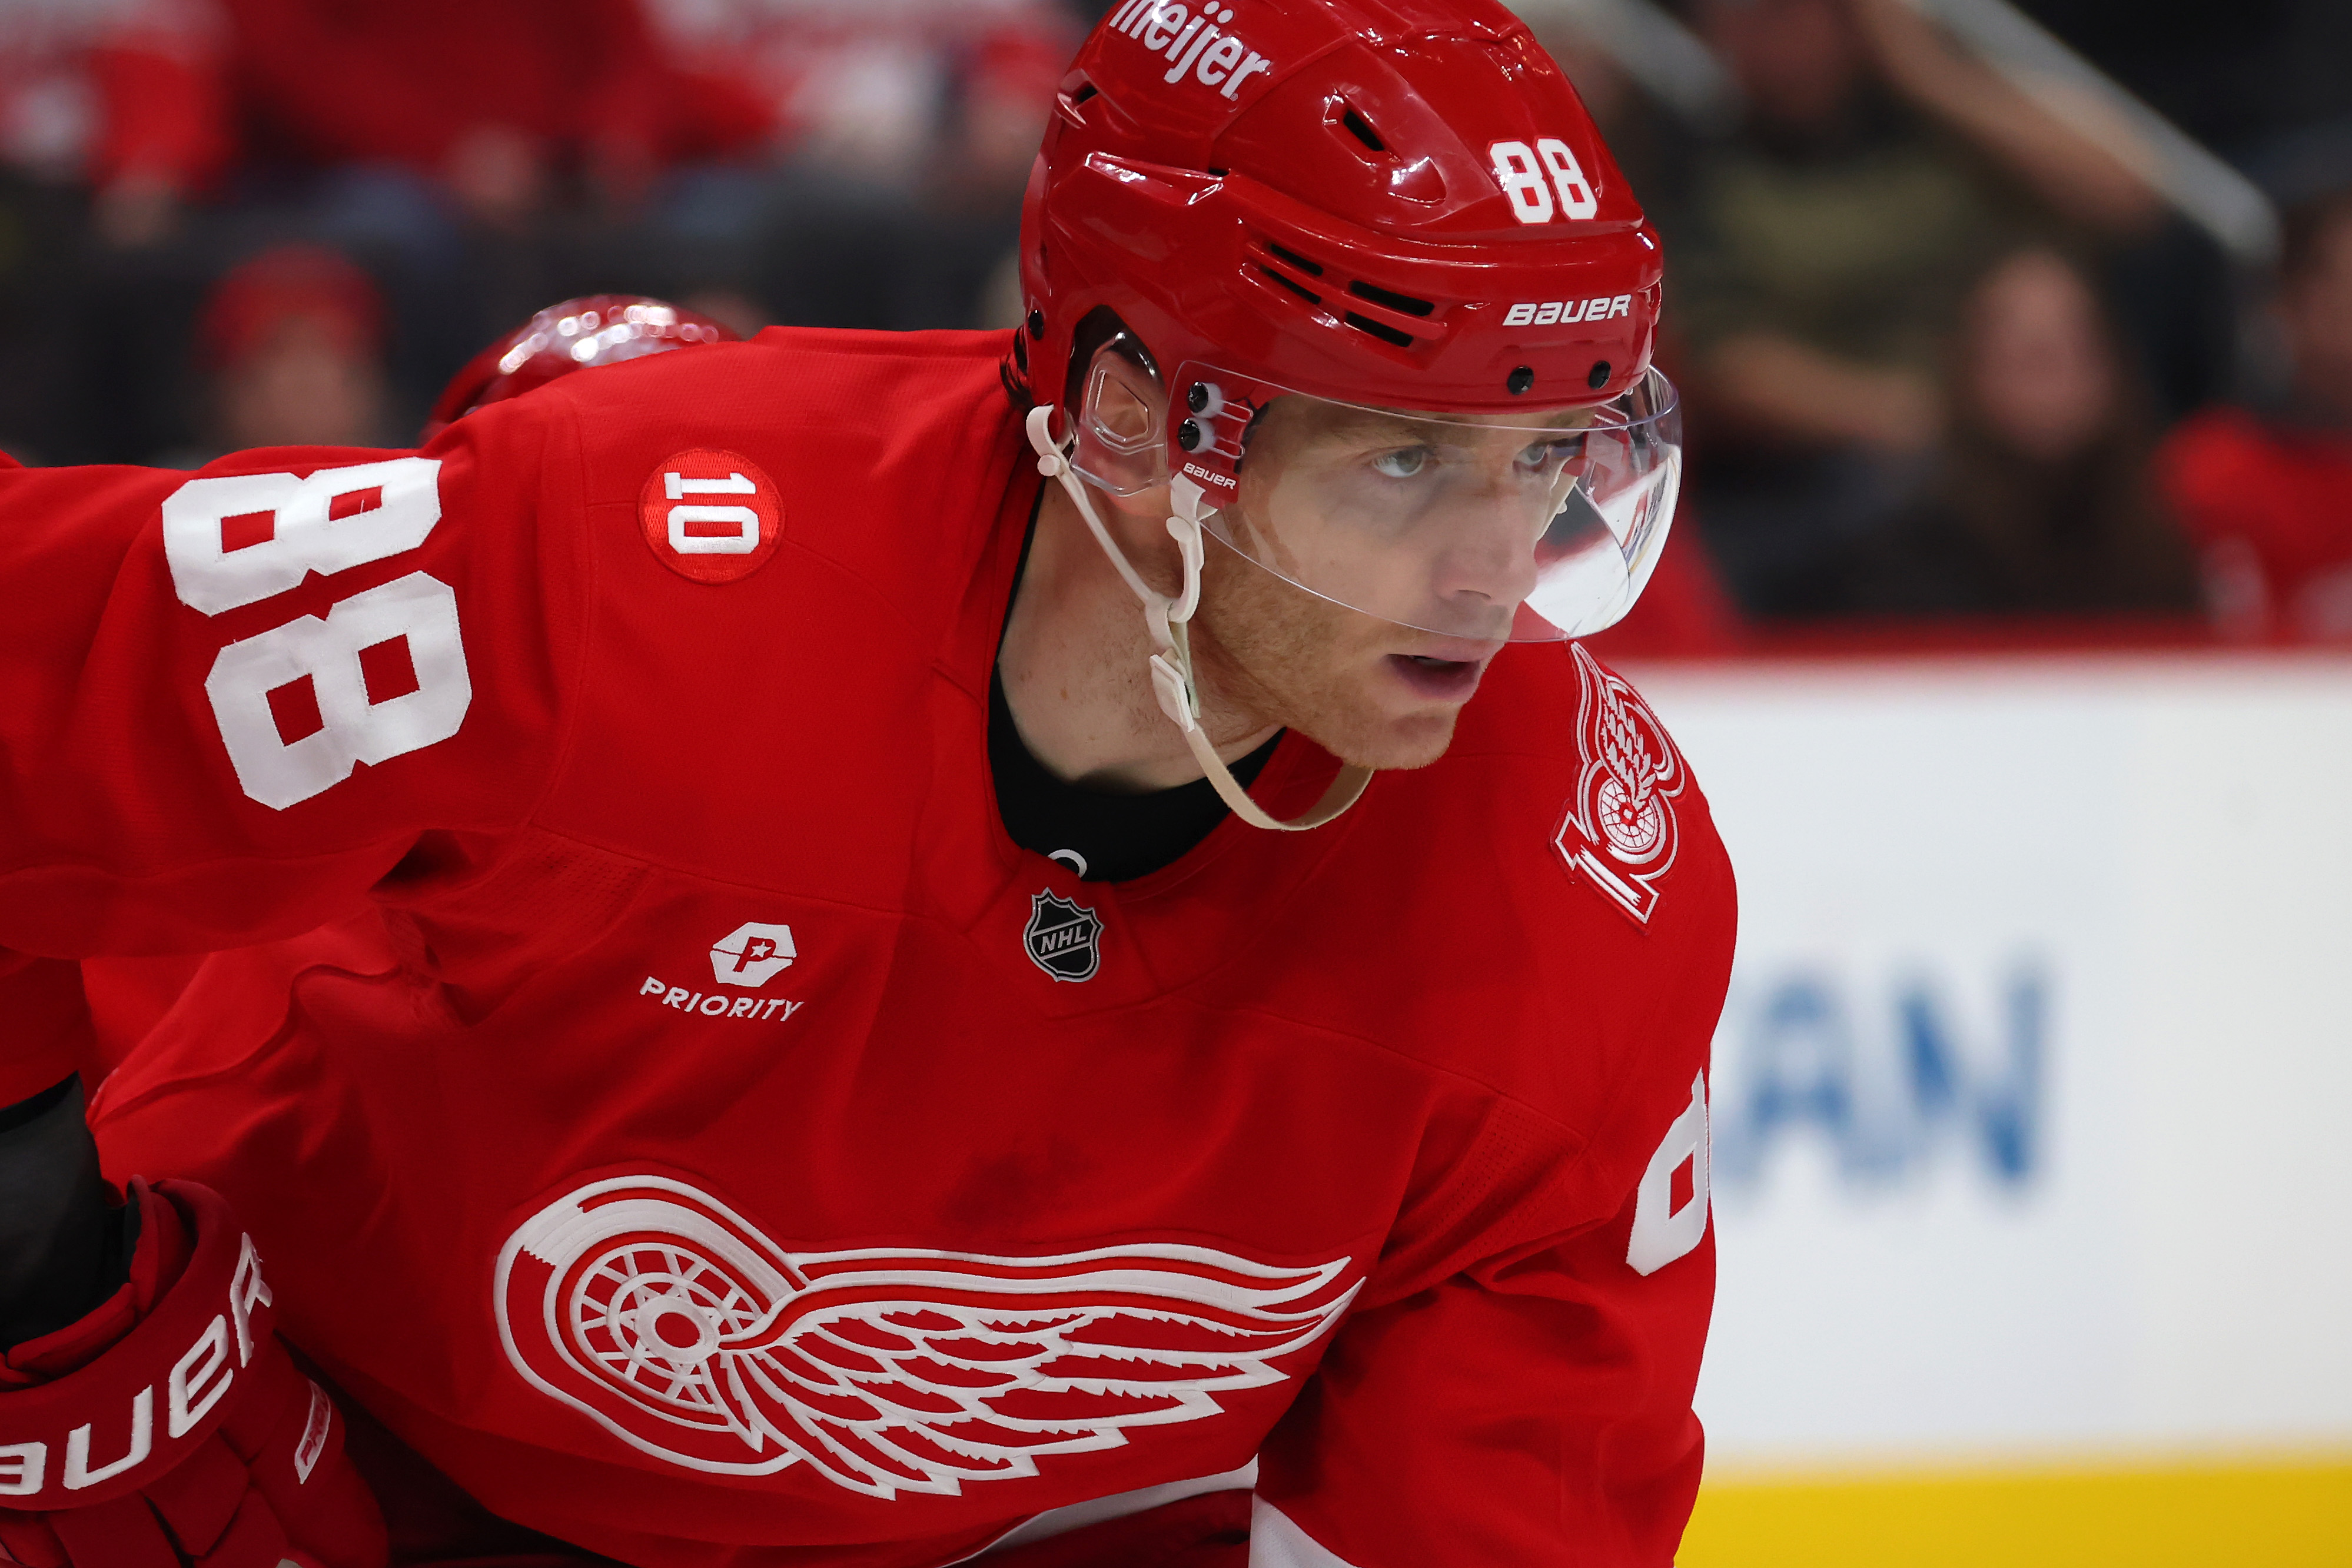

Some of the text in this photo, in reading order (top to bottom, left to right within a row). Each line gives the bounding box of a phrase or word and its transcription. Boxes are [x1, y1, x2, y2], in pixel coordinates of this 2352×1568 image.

[1490, 138, 1598, 224] 88
[1503, 294, 1632, 325] BAUER
[1183, 462, 1236, 490] BAUER
[664, 472, 760, 554] 10
[162, 456, 471, 810] 88
[1041, 925, 1087, 954] NHL
[639, 976, 805, 1022] PRIORITY
